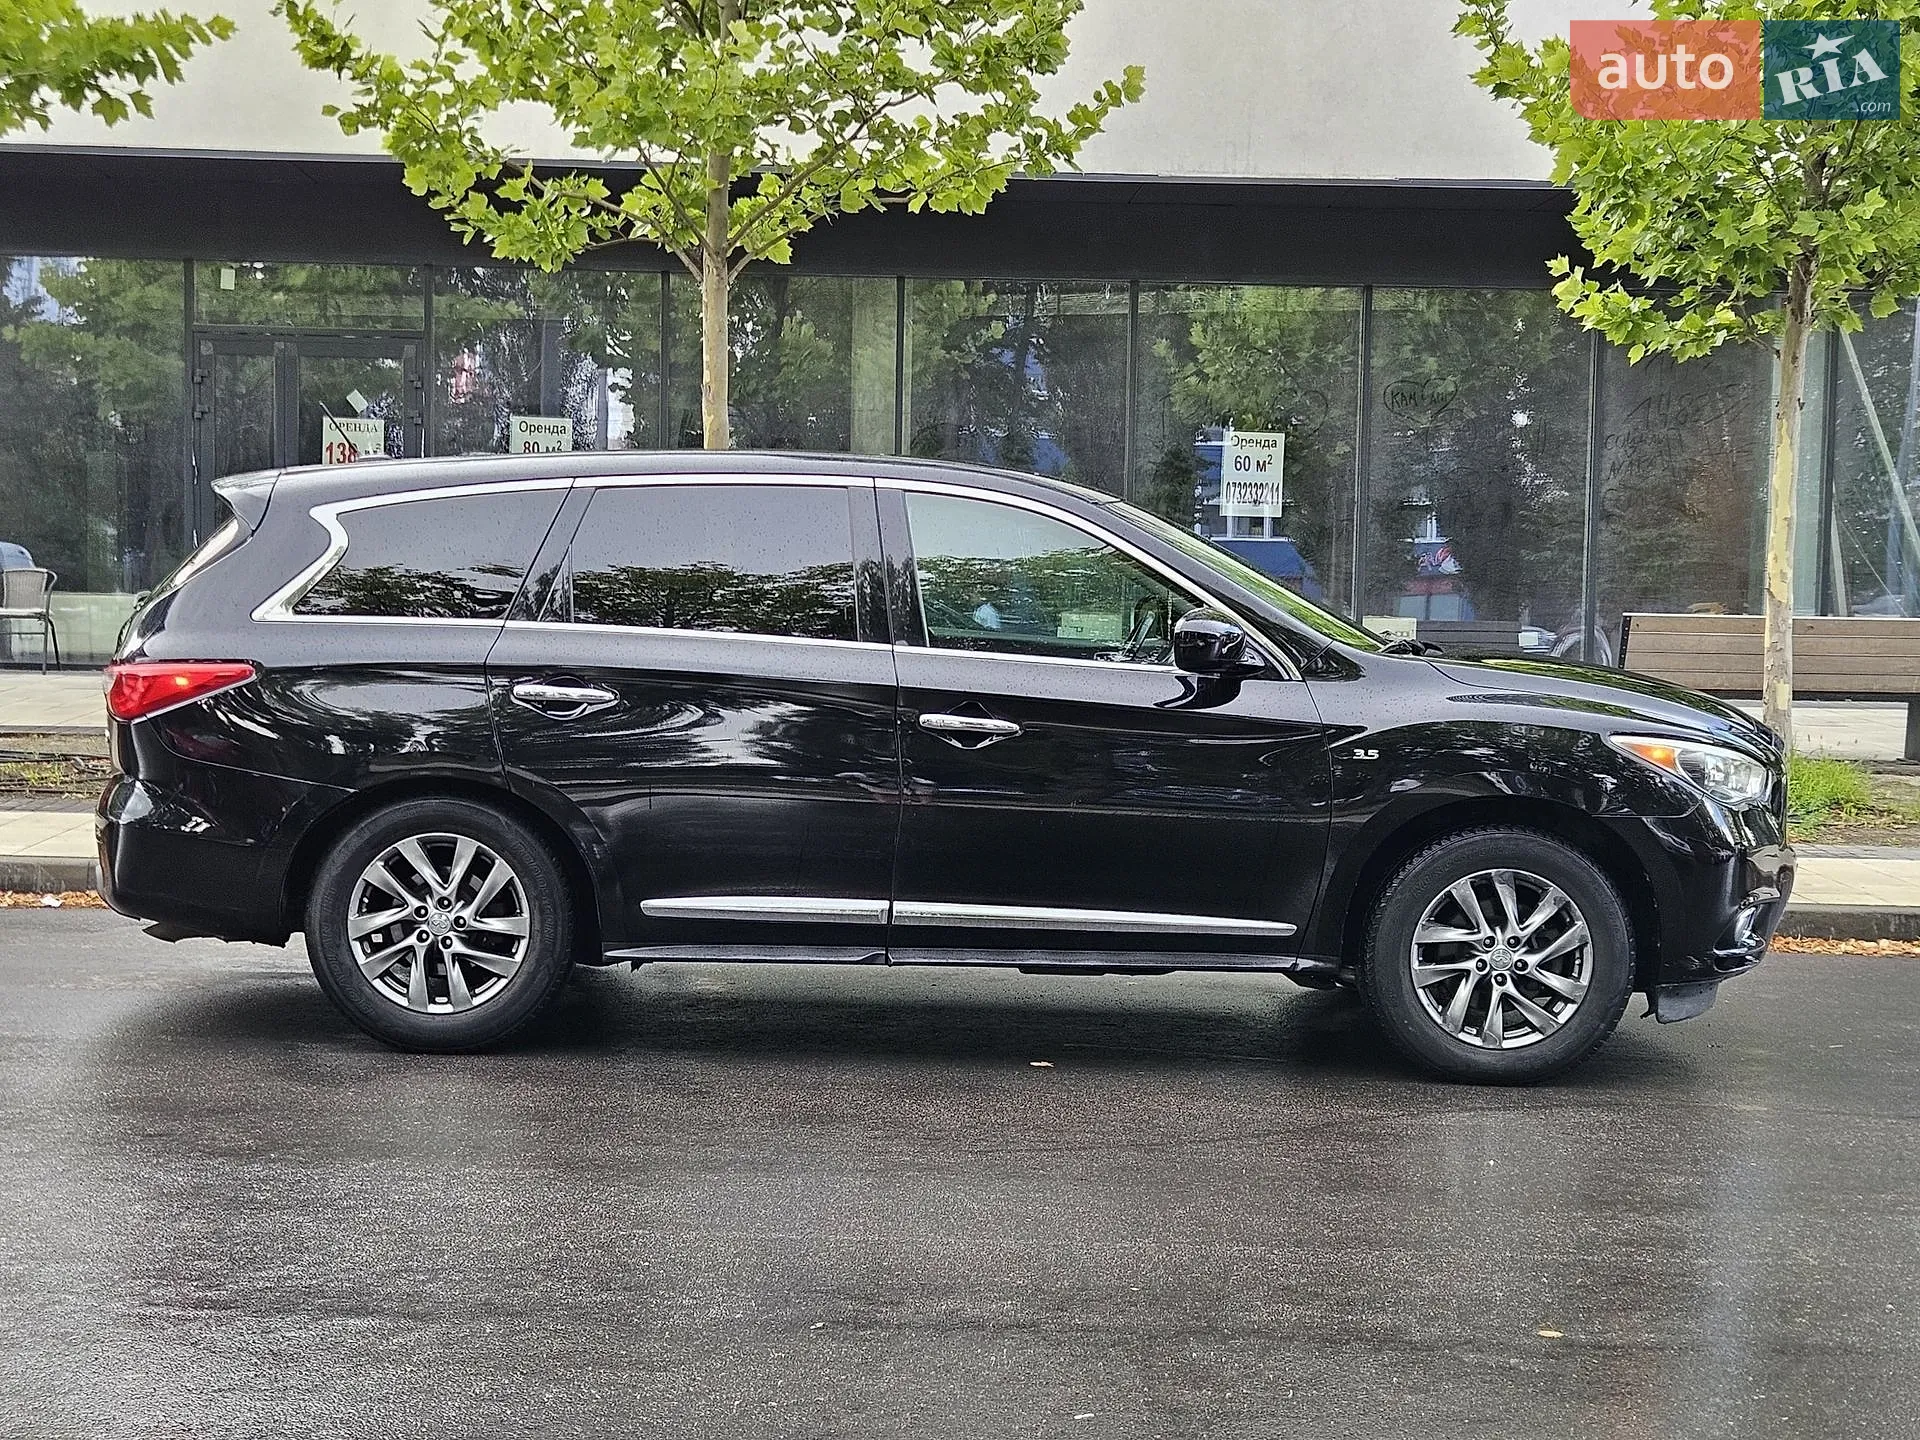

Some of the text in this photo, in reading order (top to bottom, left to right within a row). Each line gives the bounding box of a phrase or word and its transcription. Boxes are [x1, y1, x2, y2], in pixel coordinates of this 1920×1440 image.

[328, 422, 378, 433] ОРЕНДА
[519, 420, 567, 436] Оренда
[523, 440, 540, 453] 80
[1231, 434, 1278, 450] Оренда
[1234, 455, 1251, 472] 60
